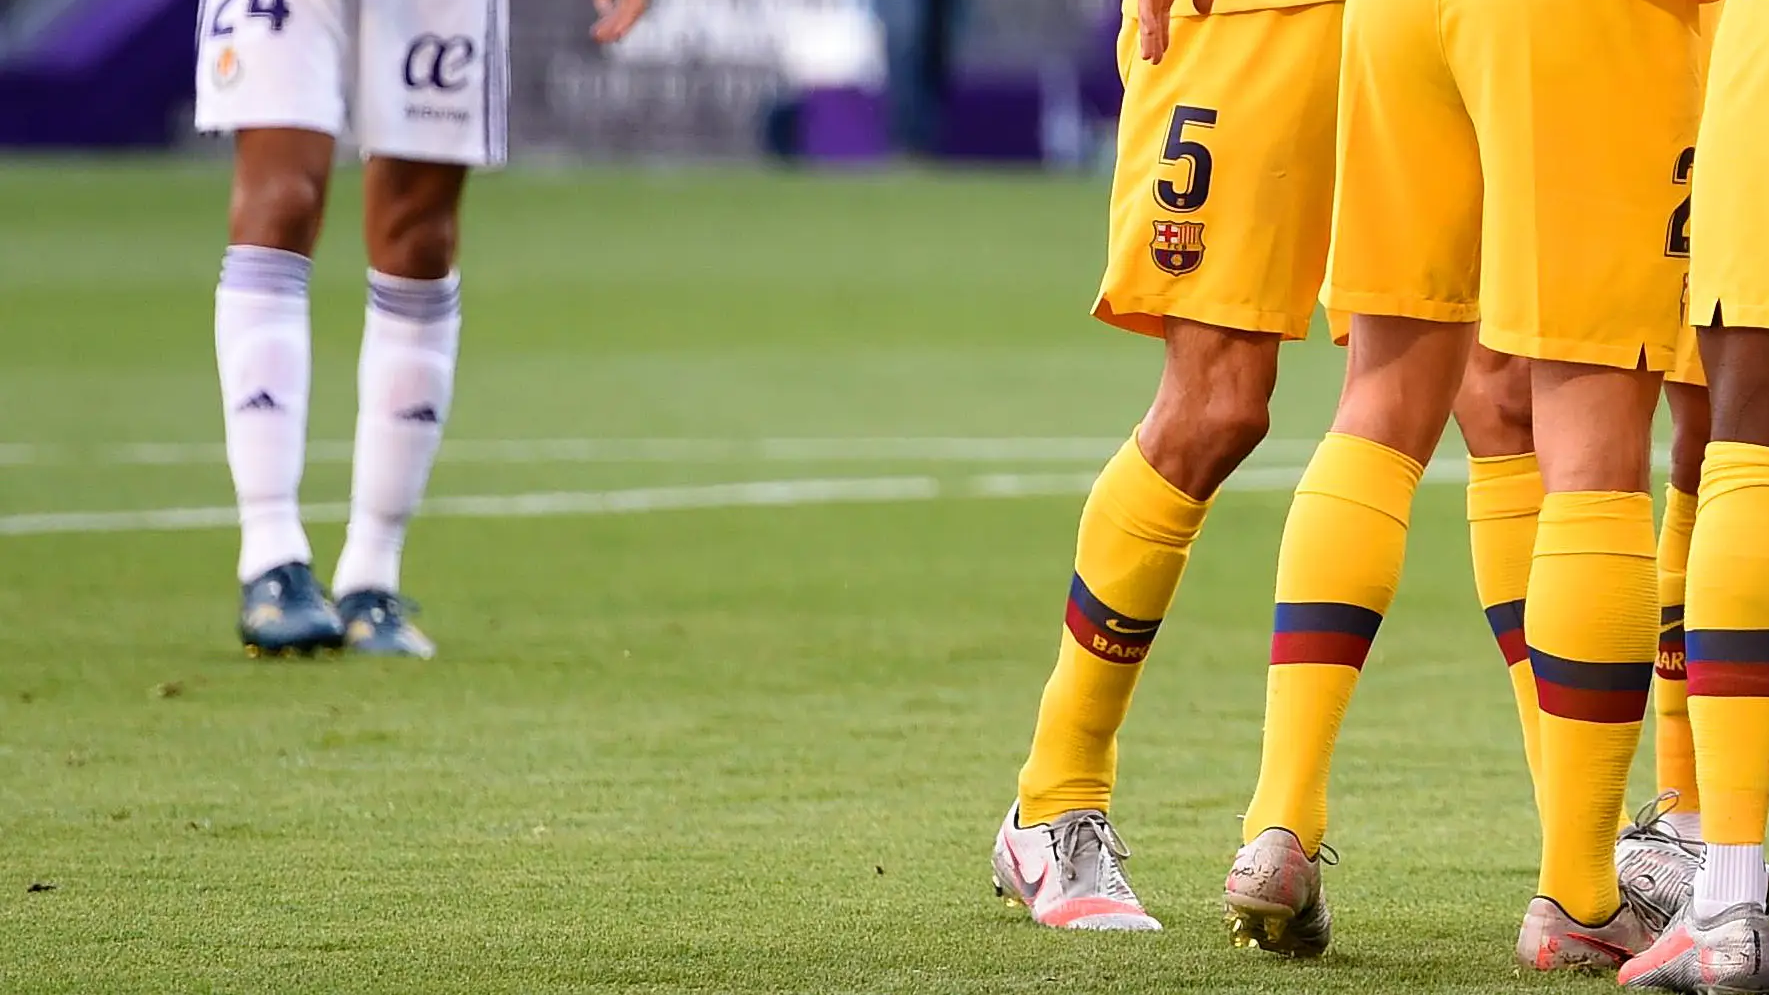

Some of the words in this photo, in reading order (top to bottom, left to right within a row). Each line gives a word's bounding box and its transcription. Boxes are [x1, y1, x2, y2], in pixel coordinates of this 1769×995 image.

[1152, 104, 1219, 214] 5
[1664, 146, 1696, 259] 2
[1092, 633, 1150, 660] BAR
